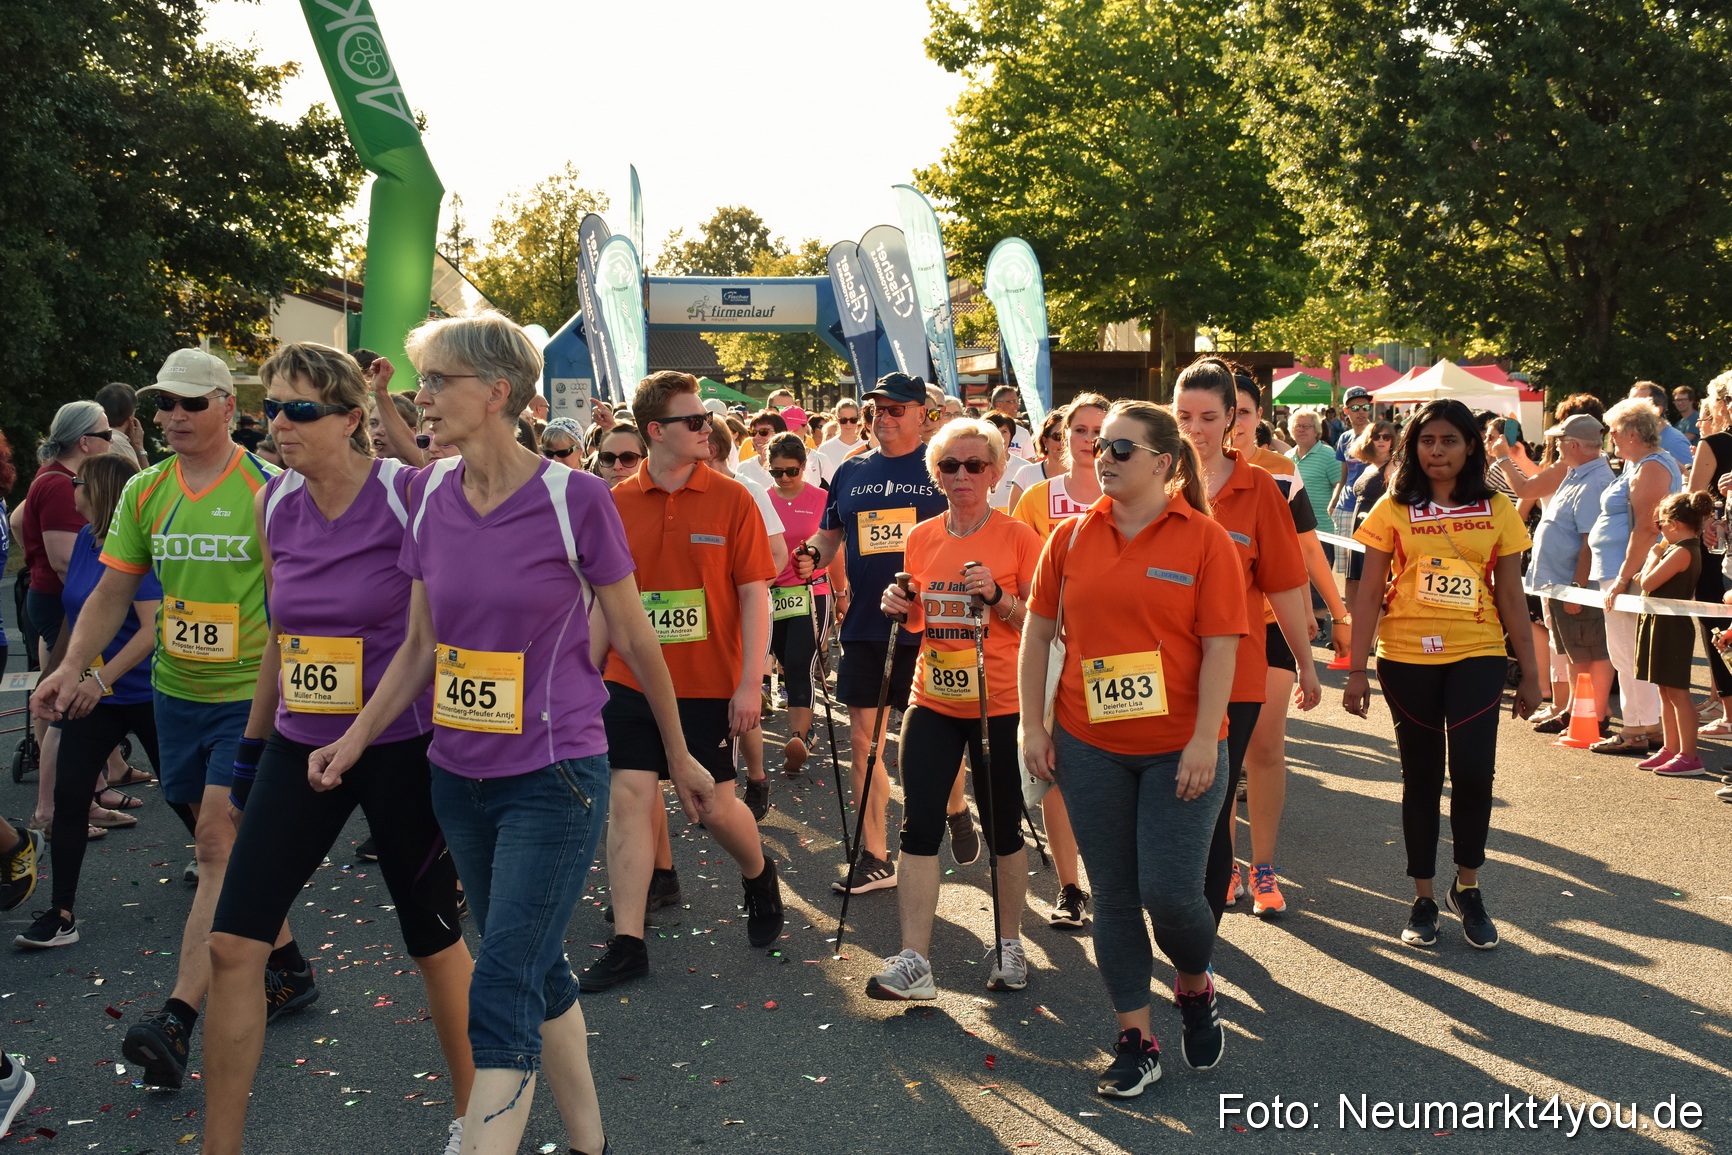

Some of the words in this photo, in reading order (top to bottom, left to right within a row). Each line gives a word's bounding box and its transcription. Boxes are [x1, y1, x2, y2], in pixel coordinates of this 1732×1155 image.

[314, 0, 420, 134] AOK
[711, 305, 776, 318] firmenlauf
[850, 483, 884, 497] EURO
[895, 483, 933, 497] POLES
[870, 523, 903, 541] 534
[1411, 524, 1448, 536] MAX
[1452, 520, 1495, 533] BÖGL
[151, 533, 251, 562] BOCK
[928, 581, 945, 591] 30
[947, 581, 968, 592] Jah
[1424, 573, 1472, 596] 1323
[774, 596, 803, 612] 2062
[648, 607, 698, 628] 1486
[175, 620, 218, 645] 218
[926, 626, 989, 640] eumart
[196, 645, 224, 653] Hermann
[290, 663, 338, 692] 466
[932, 667, 969, 687] 889
[294, 691, 312, 699] Müller
[313, 692, 332, 700] Thea
[446, 676, 497, 709] 465
[1092, 675, 1153, 703] 1483
[495, 711, 515, 719] Antje
